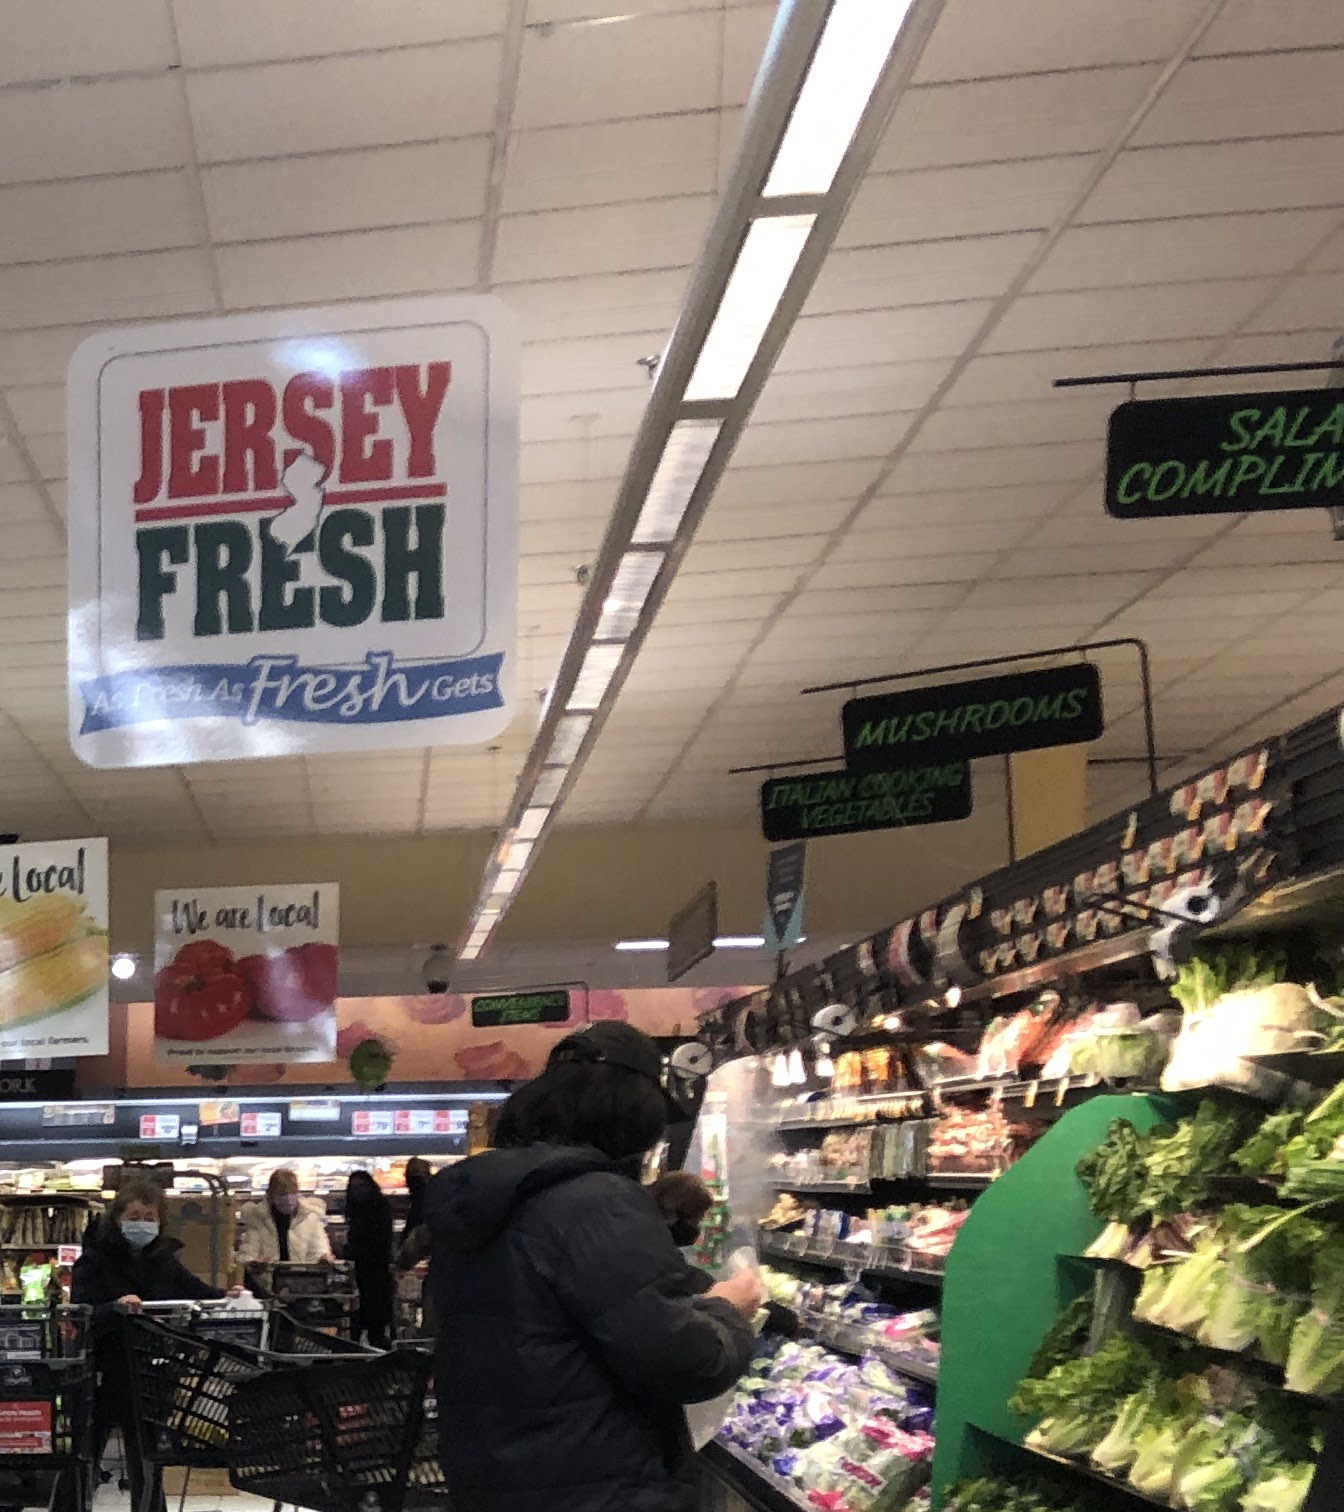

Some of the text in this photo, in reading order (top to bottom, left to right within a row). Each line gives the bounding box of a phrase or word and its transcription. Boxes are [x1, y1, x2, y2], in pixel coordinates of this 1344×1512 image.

[132, 360, 452, 504] JERSEY
[134, 502, 446, 642] FRESH
[244, 651, 430, 724] Fresh
[432, 669, 493, 700] Gets
[857, 689, 1088, 749] MUSHROOMS
[13, 847, 86, 903] Local
[172, 898, 210, 934] We
[215, 907, 252, 928] are
